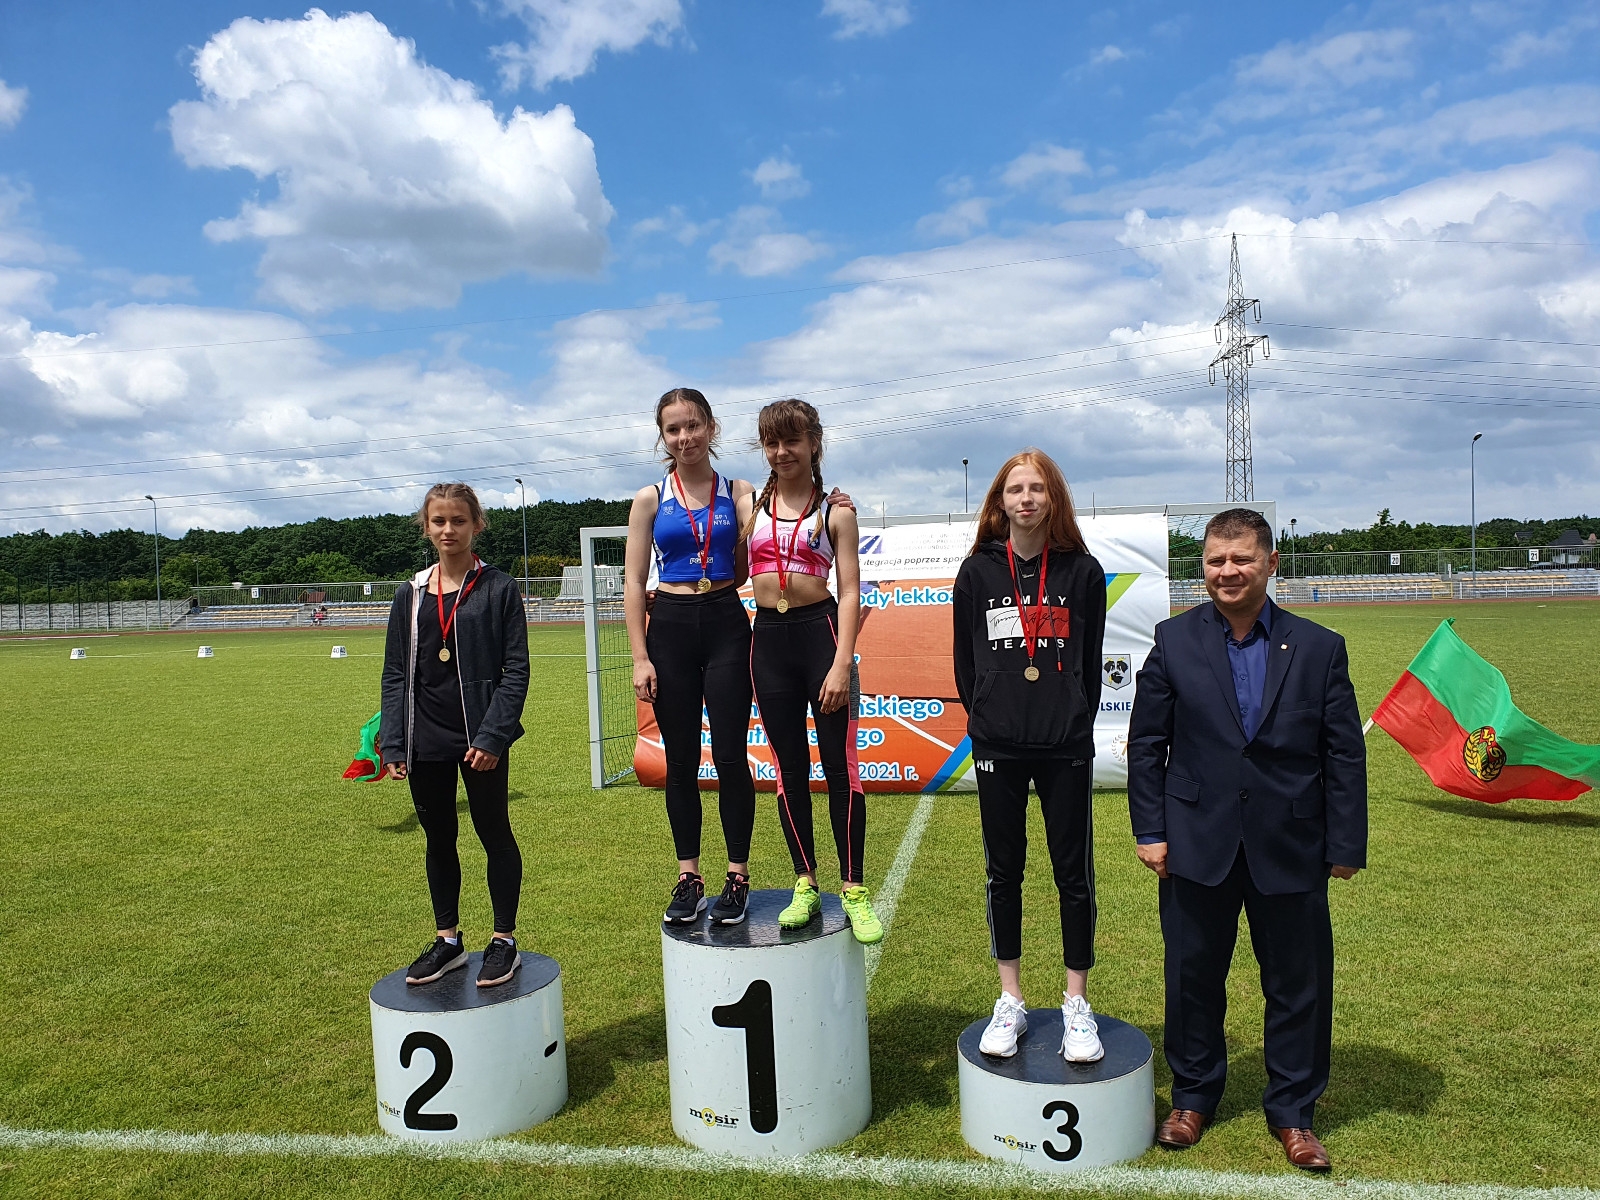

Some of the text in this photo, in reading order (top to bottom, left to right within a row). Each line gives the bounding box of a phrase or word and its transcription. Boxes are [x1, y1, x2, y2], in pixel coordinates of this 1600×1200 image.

[904, 556, 940, 566] poprzez
[943, 555, 964, 565] spor
[1391, 556, 1400, 565] 20
[1530, 552, 1538, 561] 21
[860, 590, 890, 608] ody
[992, 639, 1065, 651] JEANS
[1101, 702, 1131, 711] LSKIE
[857, 730, 883, 749] go
[906, 767, 919, 779] r.
[712, 979, 778, 1134] 1
[399, 1031, 458, 1131] 2
[1042, 1100, 1083, 1162] 3
